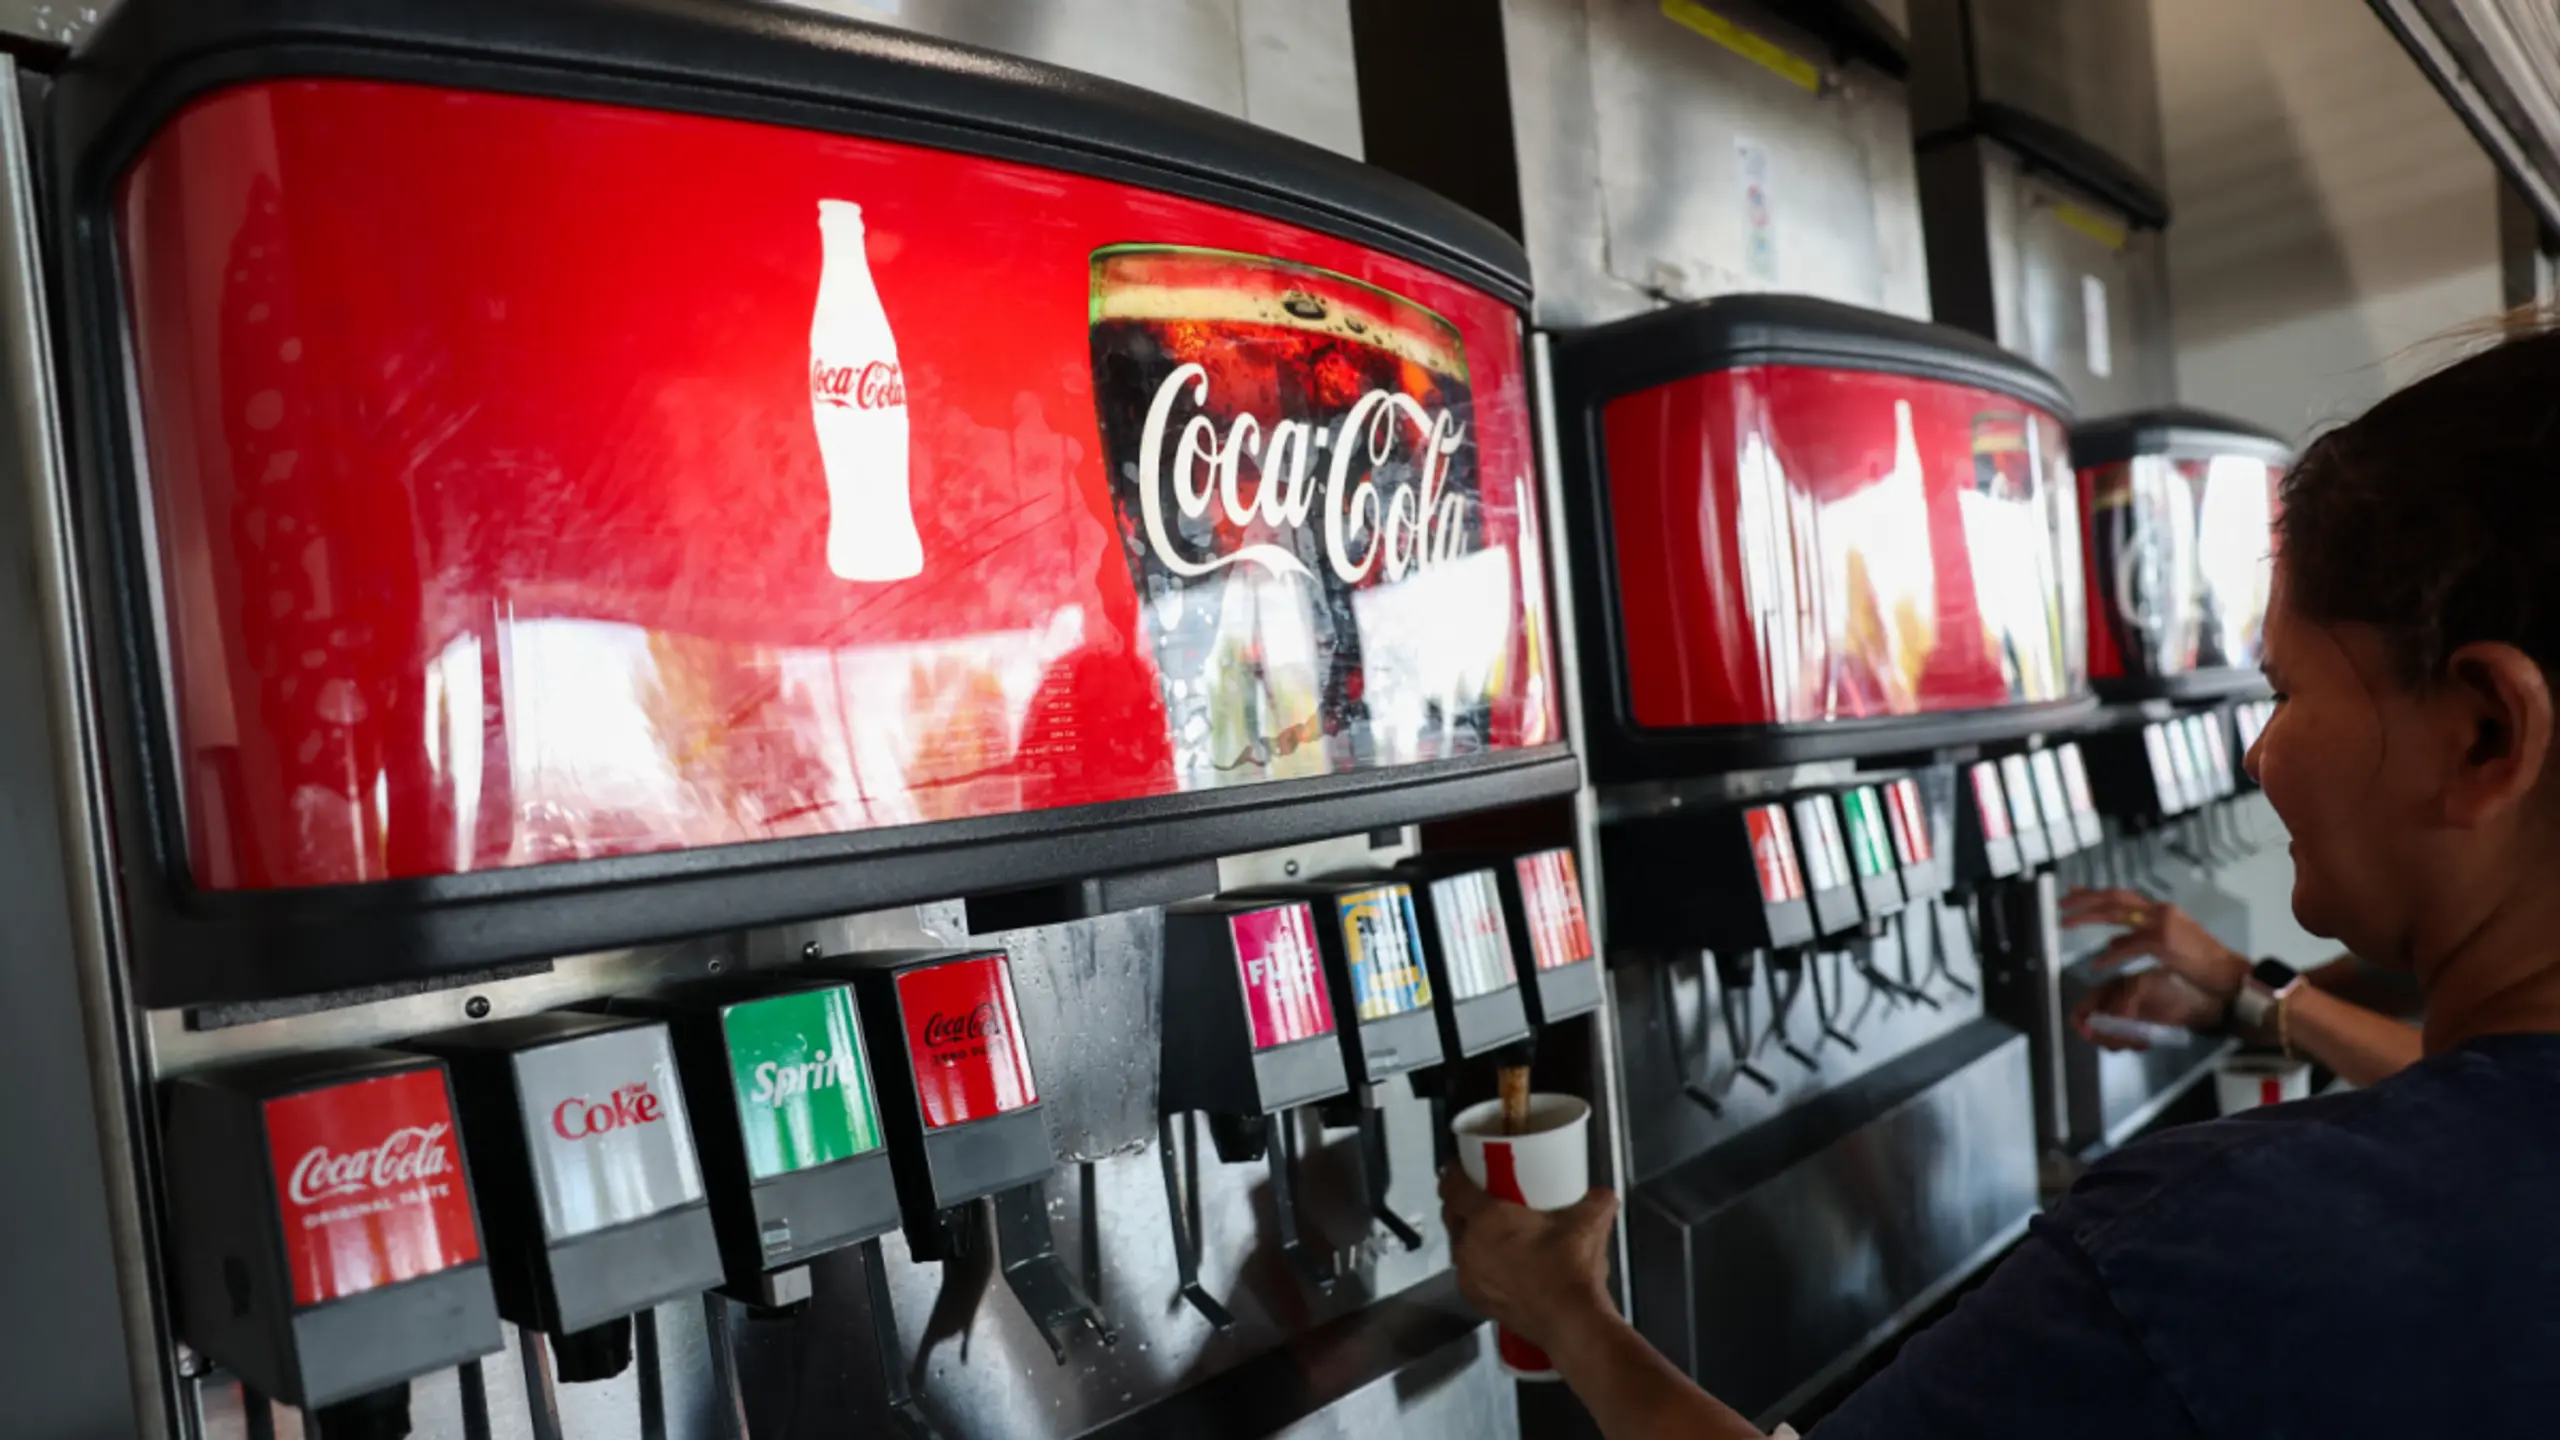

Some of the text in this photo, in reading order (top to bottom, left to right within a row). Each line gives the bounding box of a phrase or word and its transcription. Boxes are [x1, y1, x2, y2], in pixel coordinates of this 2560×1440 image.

[1140, 363, 1465, 583] Coca-Cola
[750, 1049, 842, 1108] Sprit
[552, 1090, 664, 1141] Coke
[288, 1122, 452, 1206] Coca-Cola
